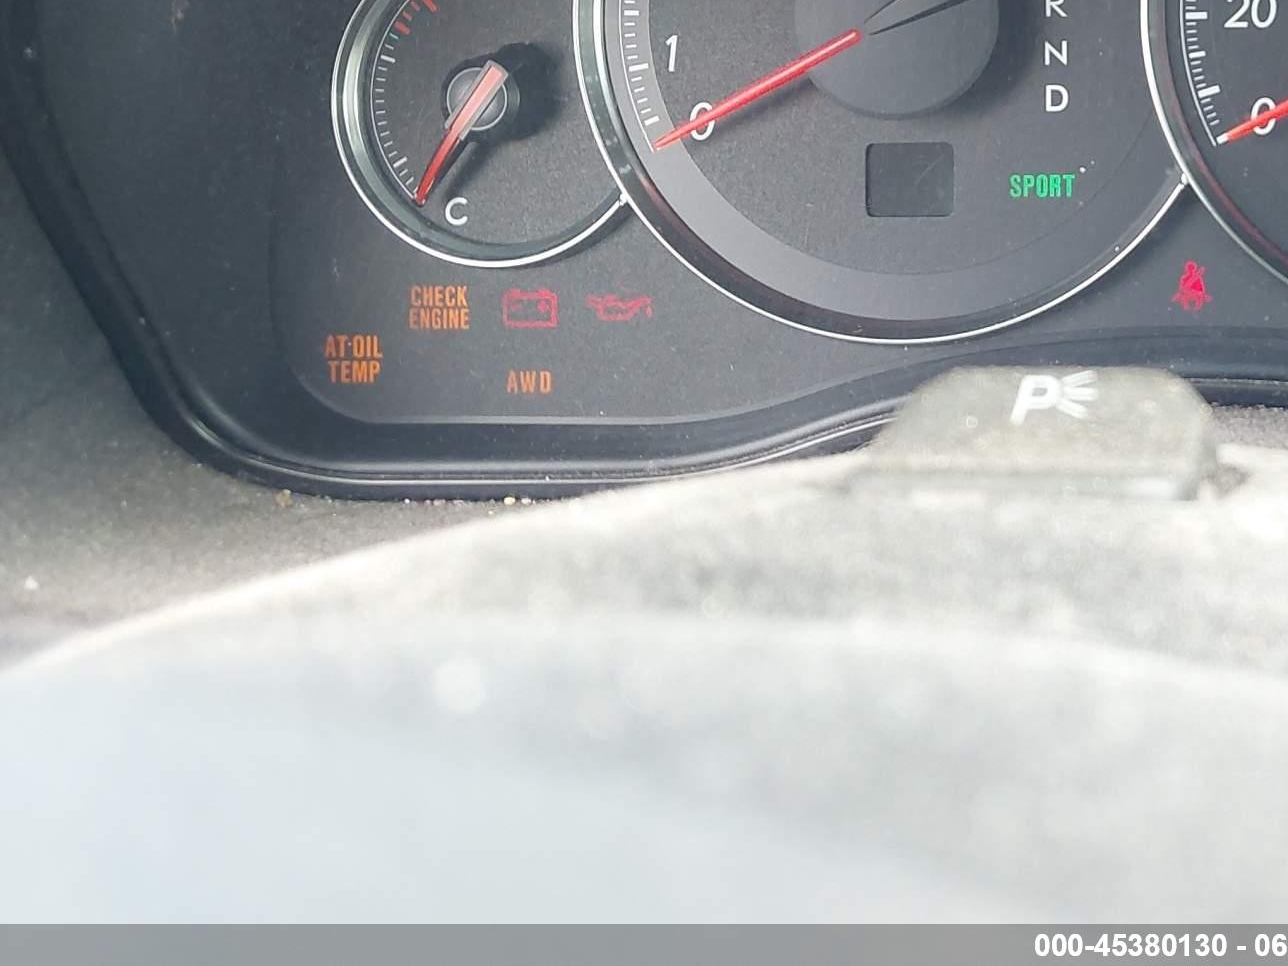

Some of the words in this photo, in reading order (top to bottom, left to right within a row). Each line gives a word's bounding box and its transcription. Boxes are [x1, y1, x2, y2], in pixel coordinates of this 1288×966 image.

[666, 35, 677, 71] 1
[1045, 41, 1067, 65] N
[1046, 85, 1068, 111] D
[690, 101, 716, 141] 0
[1251, 97, 1277, 135] 0
[1009, 174, 1075, 198] SPORT
[445, 197, 467, 226] C
[411, 286, 467, 307] CHECK
[409, 308, 469, 330] ENGINE
[328, 360, 381, 383] TEMP
[507, 370, 552, 394] AWD
